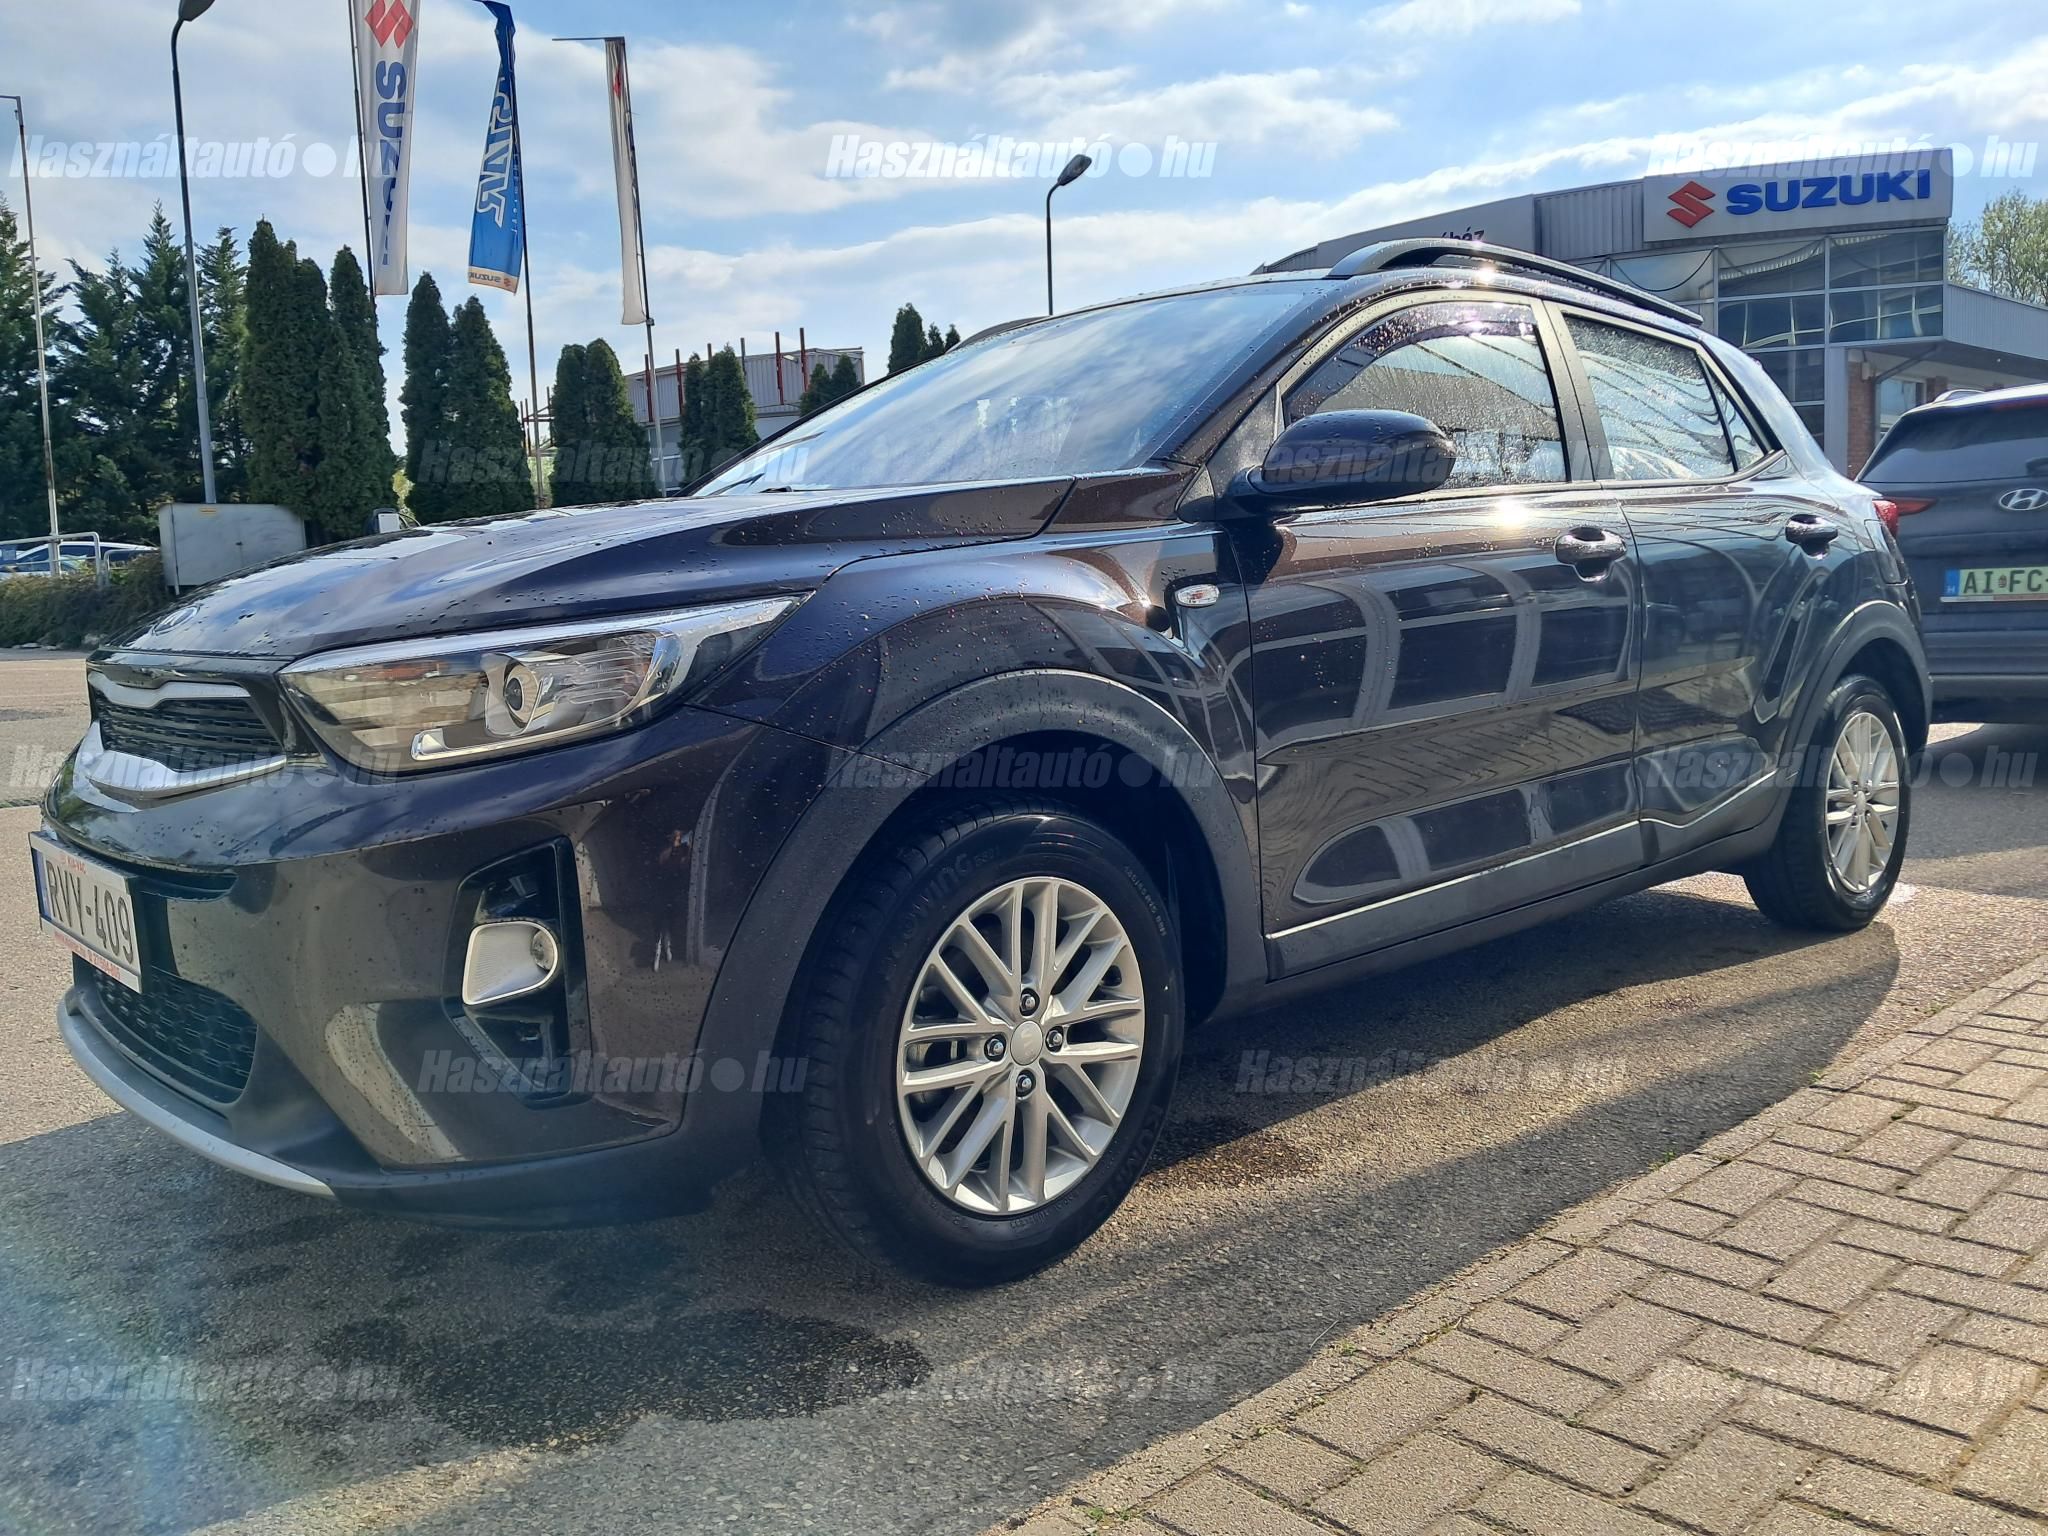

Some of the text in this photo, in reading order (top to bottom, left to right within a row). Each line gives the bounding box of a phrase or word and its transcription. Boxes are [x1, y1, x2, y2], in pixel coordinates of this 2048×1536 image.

[375, 60, 407, 266] SUZU
[1726, 169, 1931, 216] SUZUKI
[2009, 569, 2048, 592] FC
[46, 860, 134, 964] RVY-409
